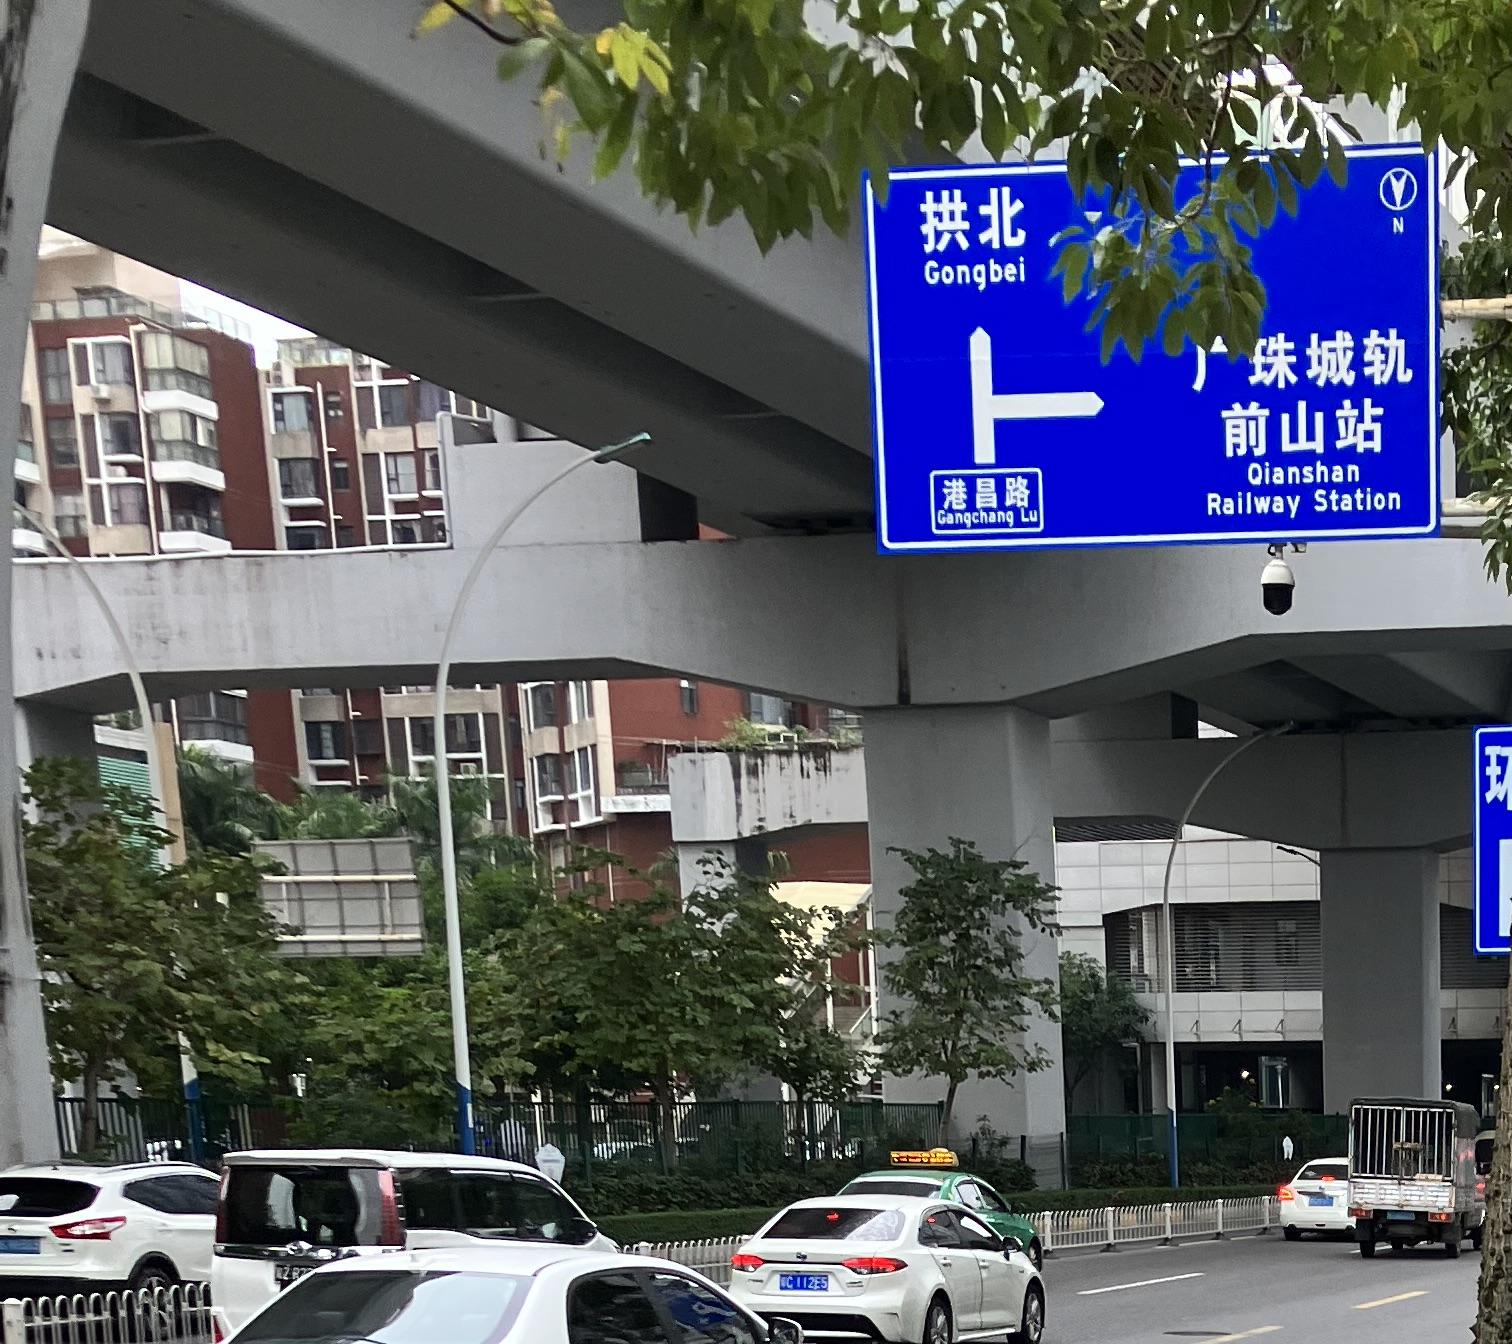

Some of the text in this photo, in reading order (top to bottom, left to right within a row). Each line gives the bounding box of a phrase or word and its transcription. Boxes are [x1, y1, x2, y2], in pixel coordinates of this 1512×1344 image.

[920, 186, 1027, 254] 拱北
[1392, 217, 1404, 234] N
[923, 258, 1027, 293] Gongbei
[1221, 397, 1384, 458] 前山站
[1247, 460, 1360, 486] Qianshan
[942, 475, 1031, 511] 港昌路
[1207, 487, 1401, 519] Railway Station
[937, 507, 1038, 528] Gangchang Lu
